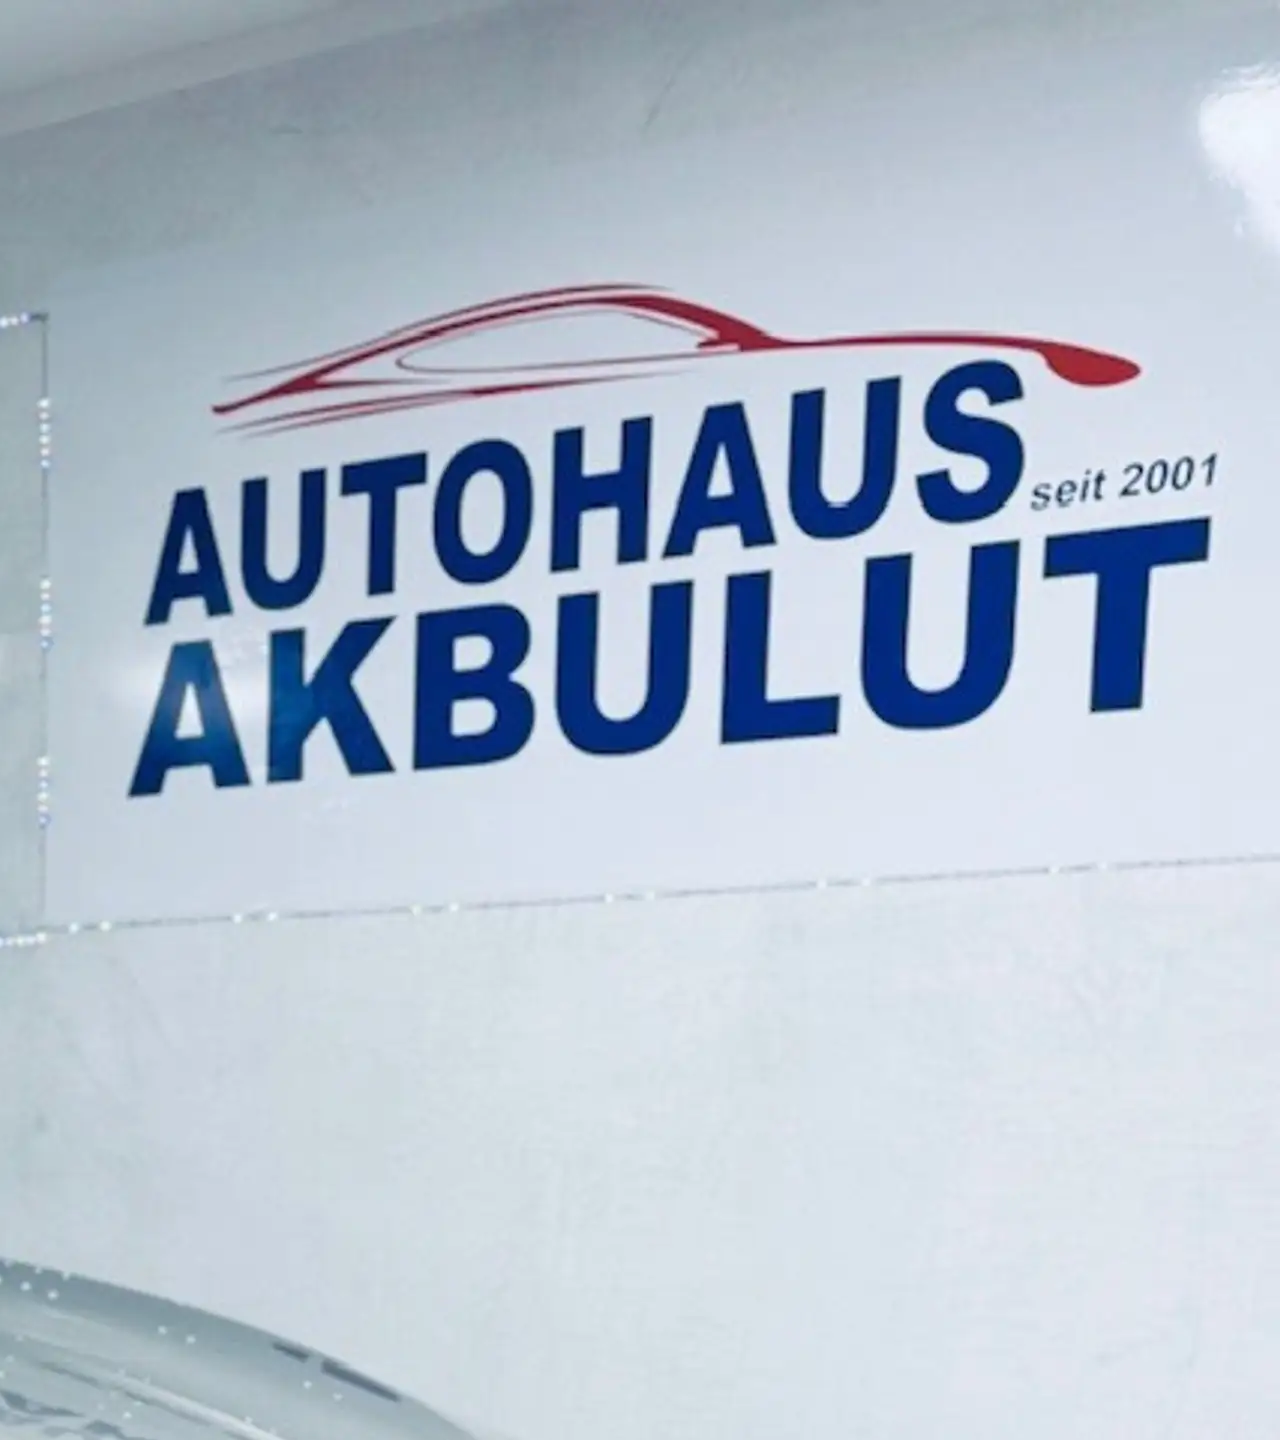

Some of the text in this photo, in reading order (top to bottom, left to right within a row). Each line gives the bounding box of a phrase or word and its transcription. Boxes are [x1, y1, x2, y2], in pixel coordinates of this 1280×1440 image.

[144, 360, 1025, 626] AUTOHAUS
[1030, 453, 1218, 511] seit 2001
[128, 516, 1211, 798] AKBULUT
